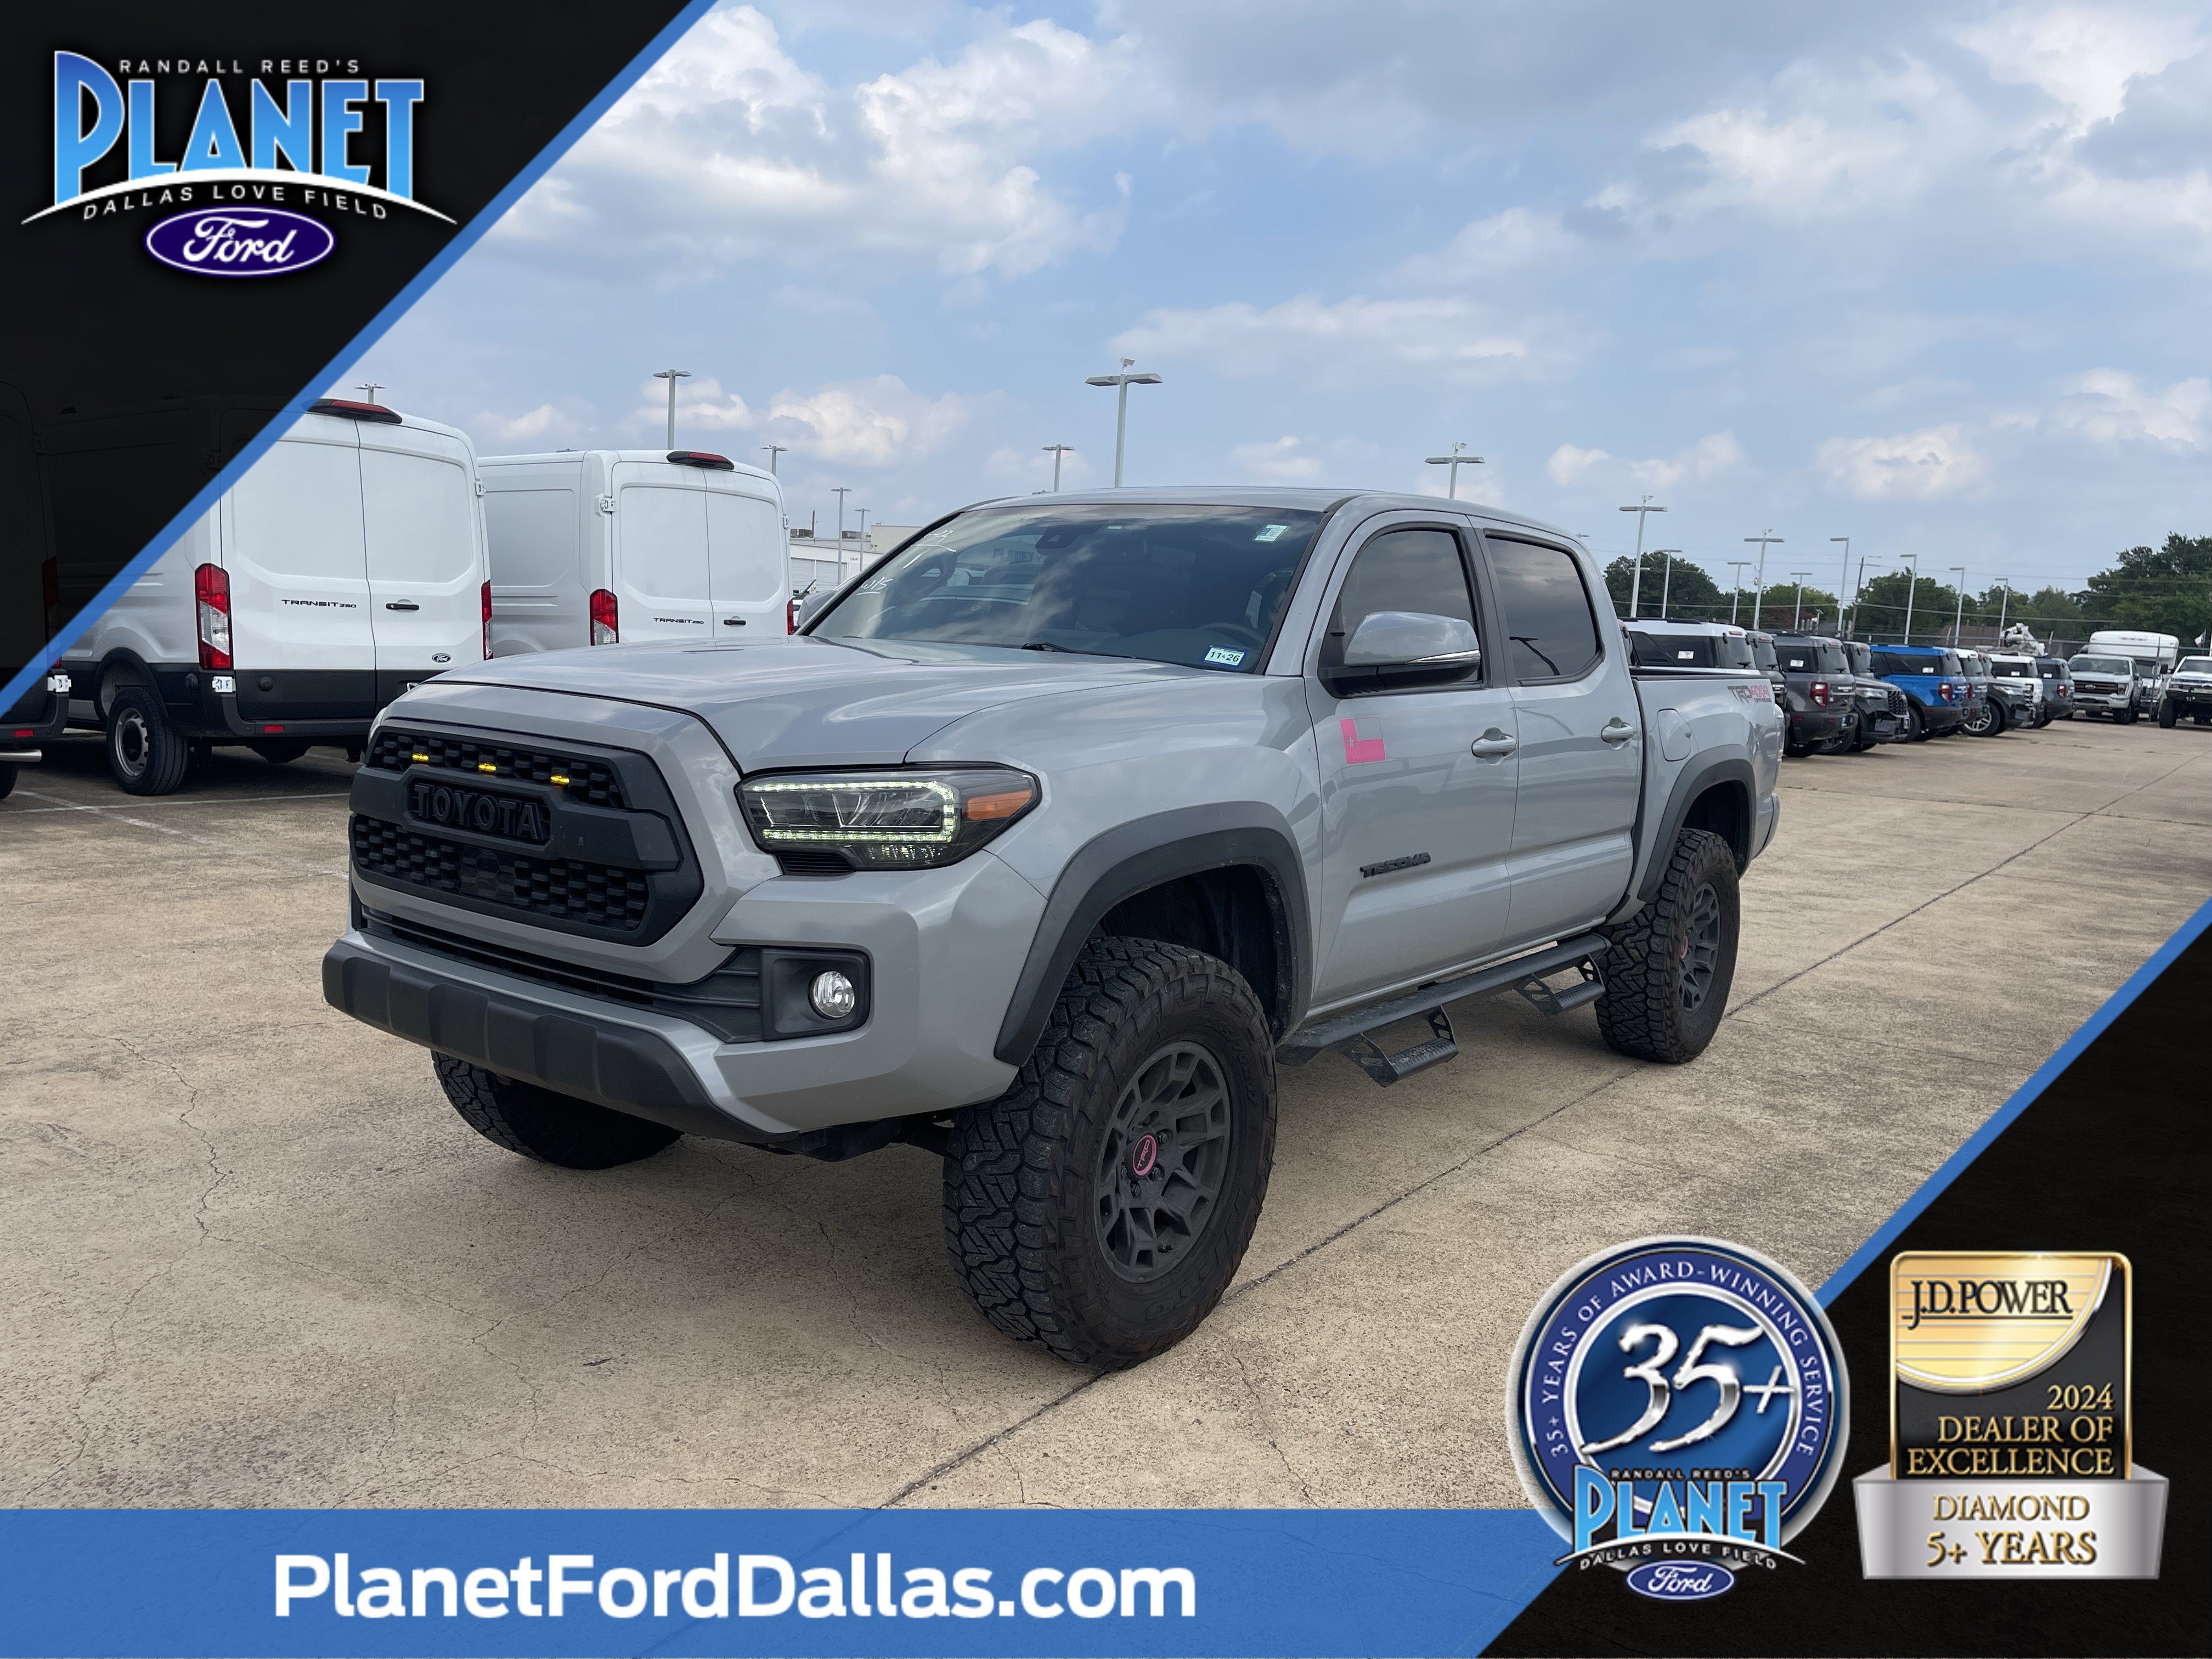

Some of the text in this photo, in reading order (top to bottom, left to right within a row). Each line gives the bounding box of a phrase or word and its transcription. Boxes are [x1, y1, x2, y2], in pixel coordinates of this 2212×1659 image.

[281, 599, 339, 607] TRANSIT
[1728, 686, 1752, 703] TRD
[414, 783, 545, 840] TOYOTA
[1359, 852, 1431, 878] TACOMA
[1136, 1139, 1150, 1170] TRD
